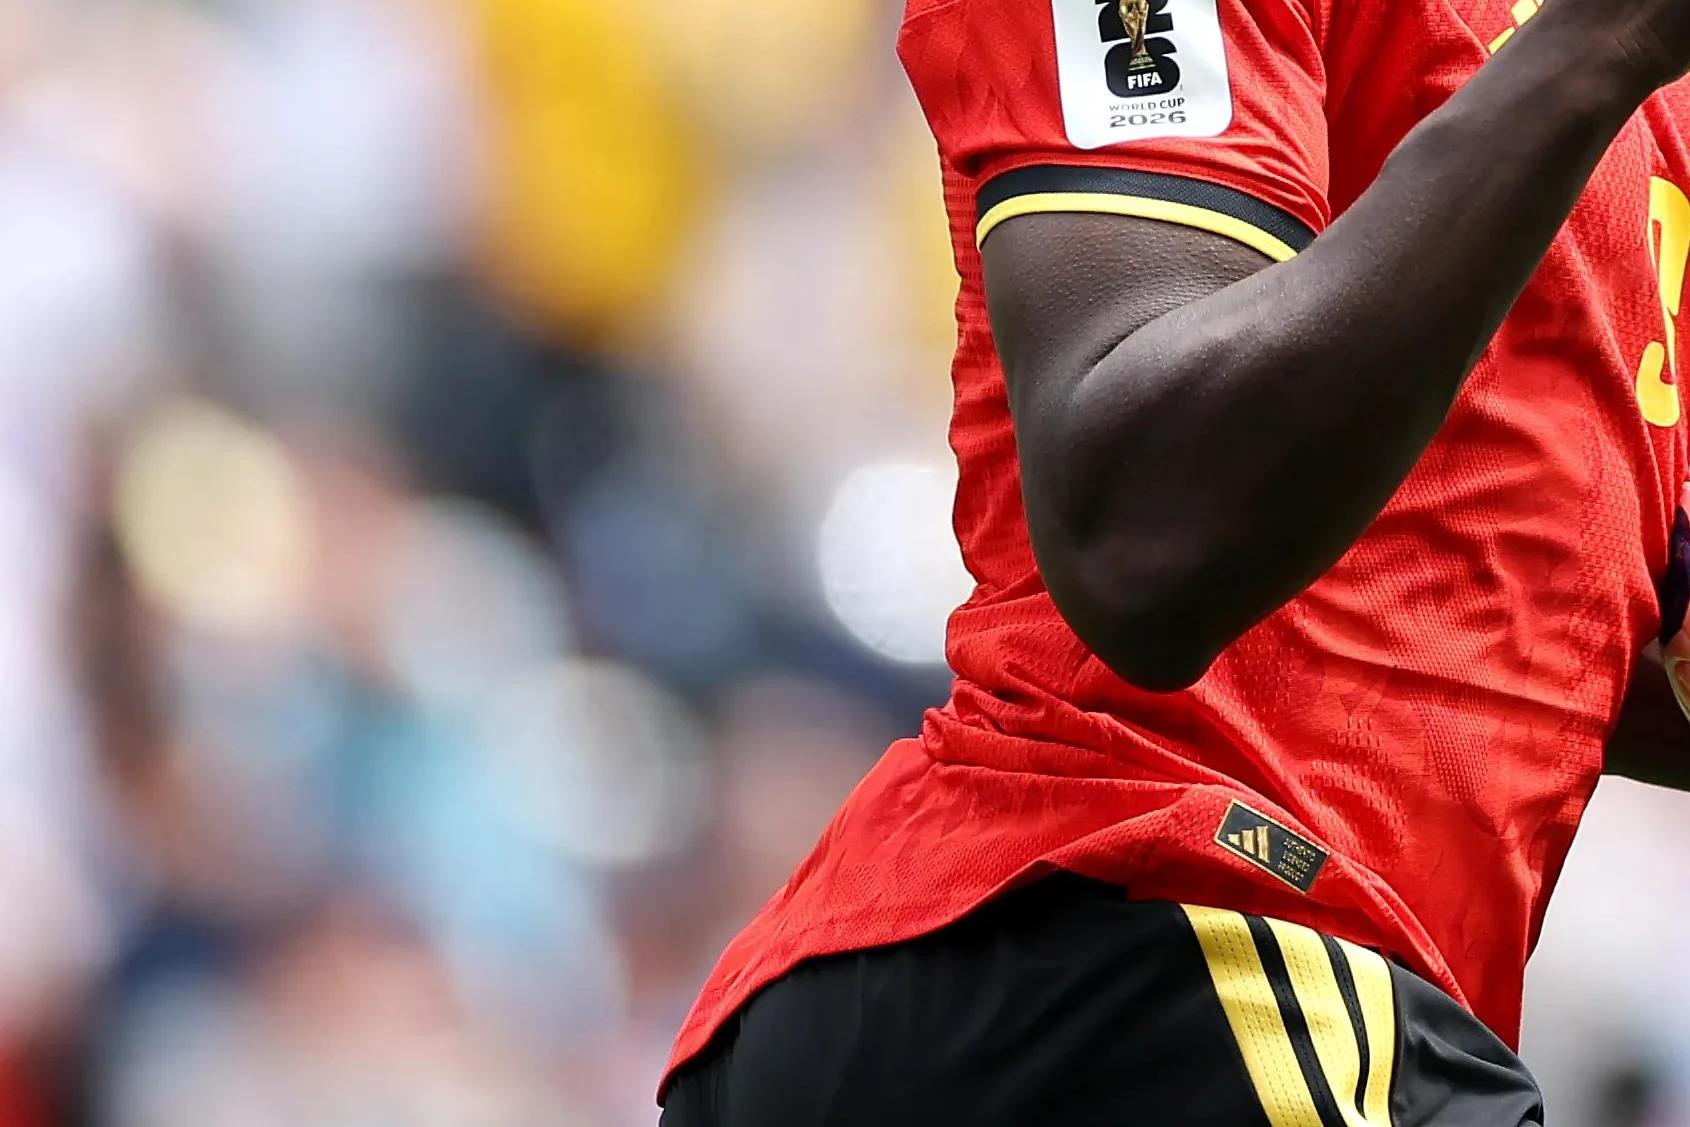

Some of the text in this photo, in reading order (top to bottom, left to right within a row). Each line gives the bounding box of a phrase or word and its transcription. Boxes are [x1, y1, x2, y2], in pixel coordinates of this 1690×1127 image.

[1127, 72, 1162, 90] FIFA
[1109, 97, 1185, 112] WORLD CUP
[1109, 110, 1186, 128] 2026
